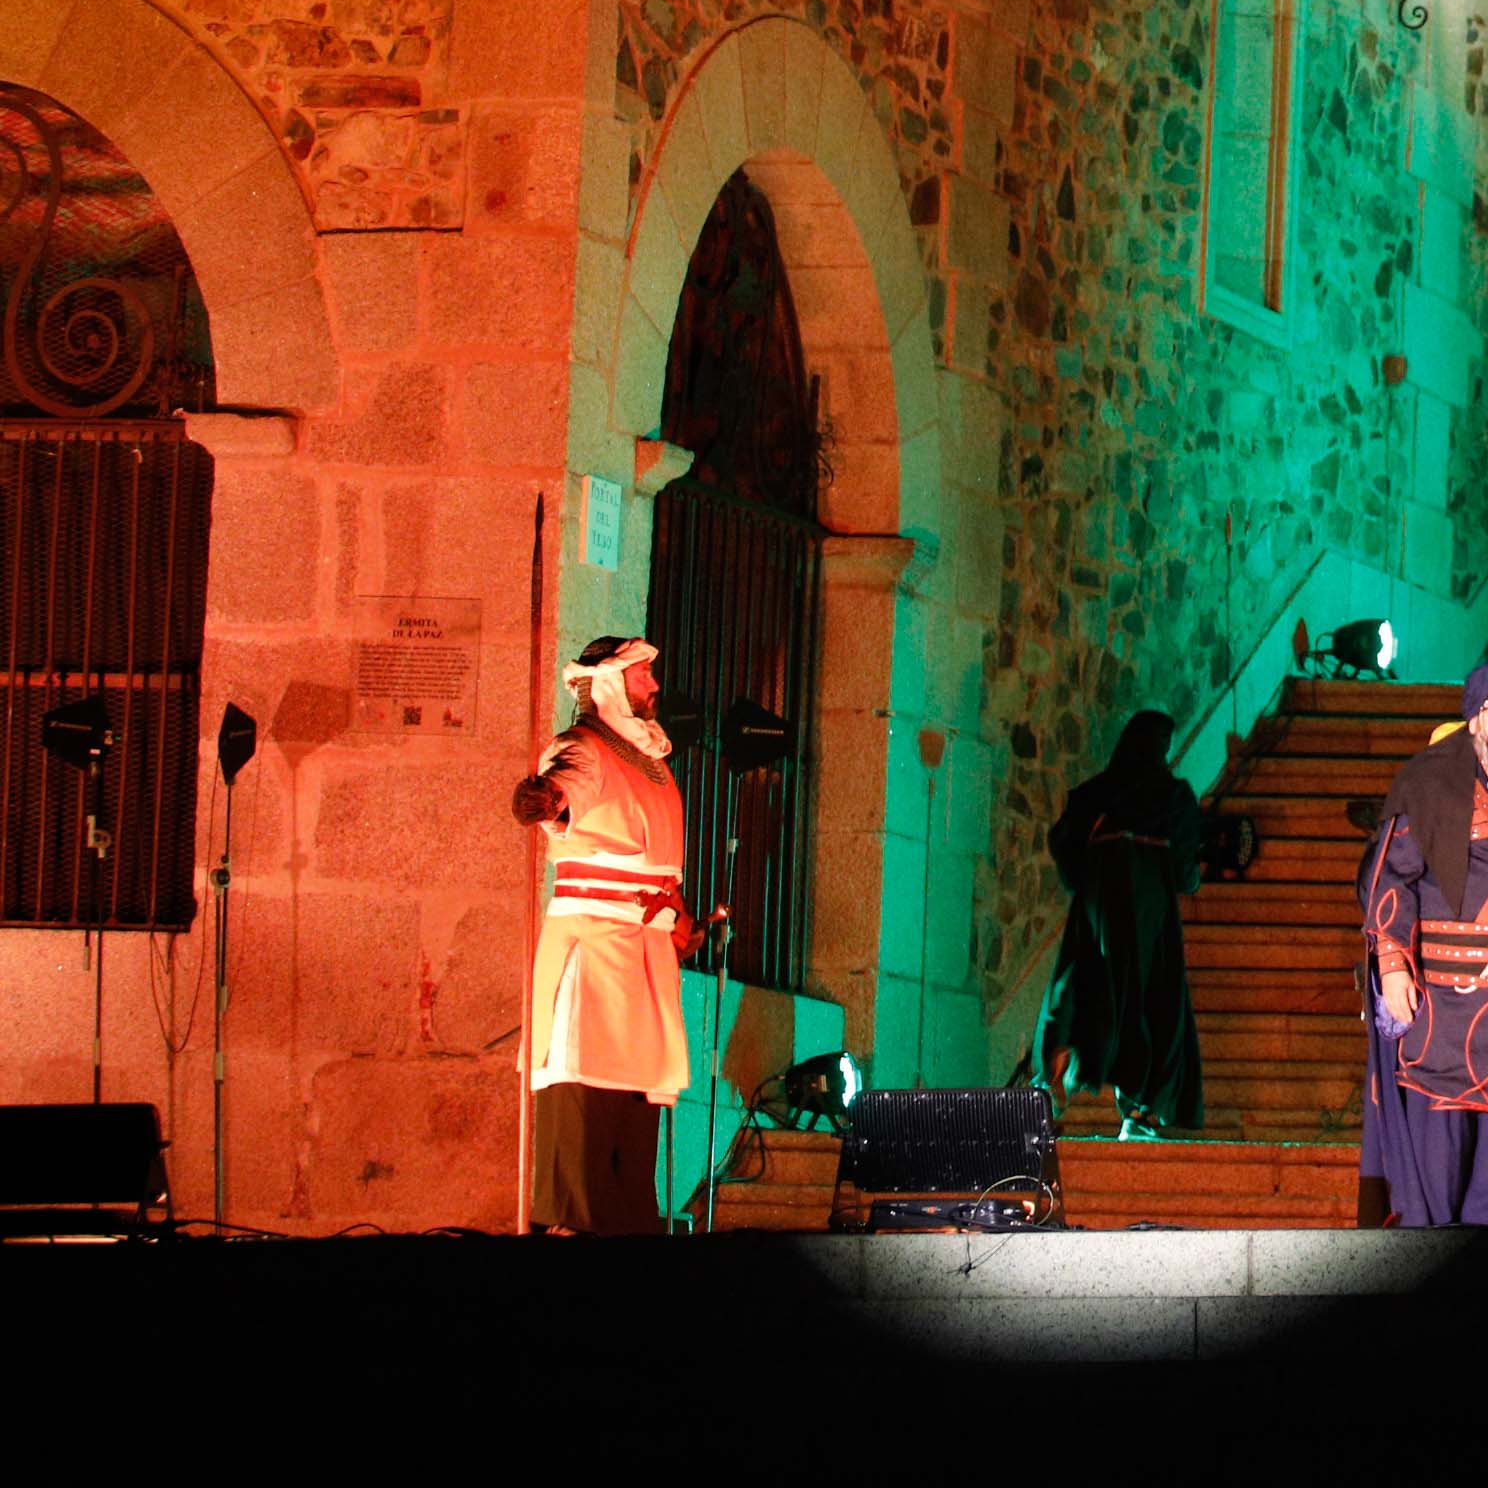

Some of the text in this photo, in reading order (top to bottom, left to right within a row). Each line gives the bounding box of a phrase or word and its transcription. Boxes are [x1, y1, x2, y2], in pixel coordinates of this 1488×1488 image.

[596, 511, 611, 527] DEL
[398, 618, 438, 628] ERMITA
[392, 629, 443, 639] DE LA PAZ
